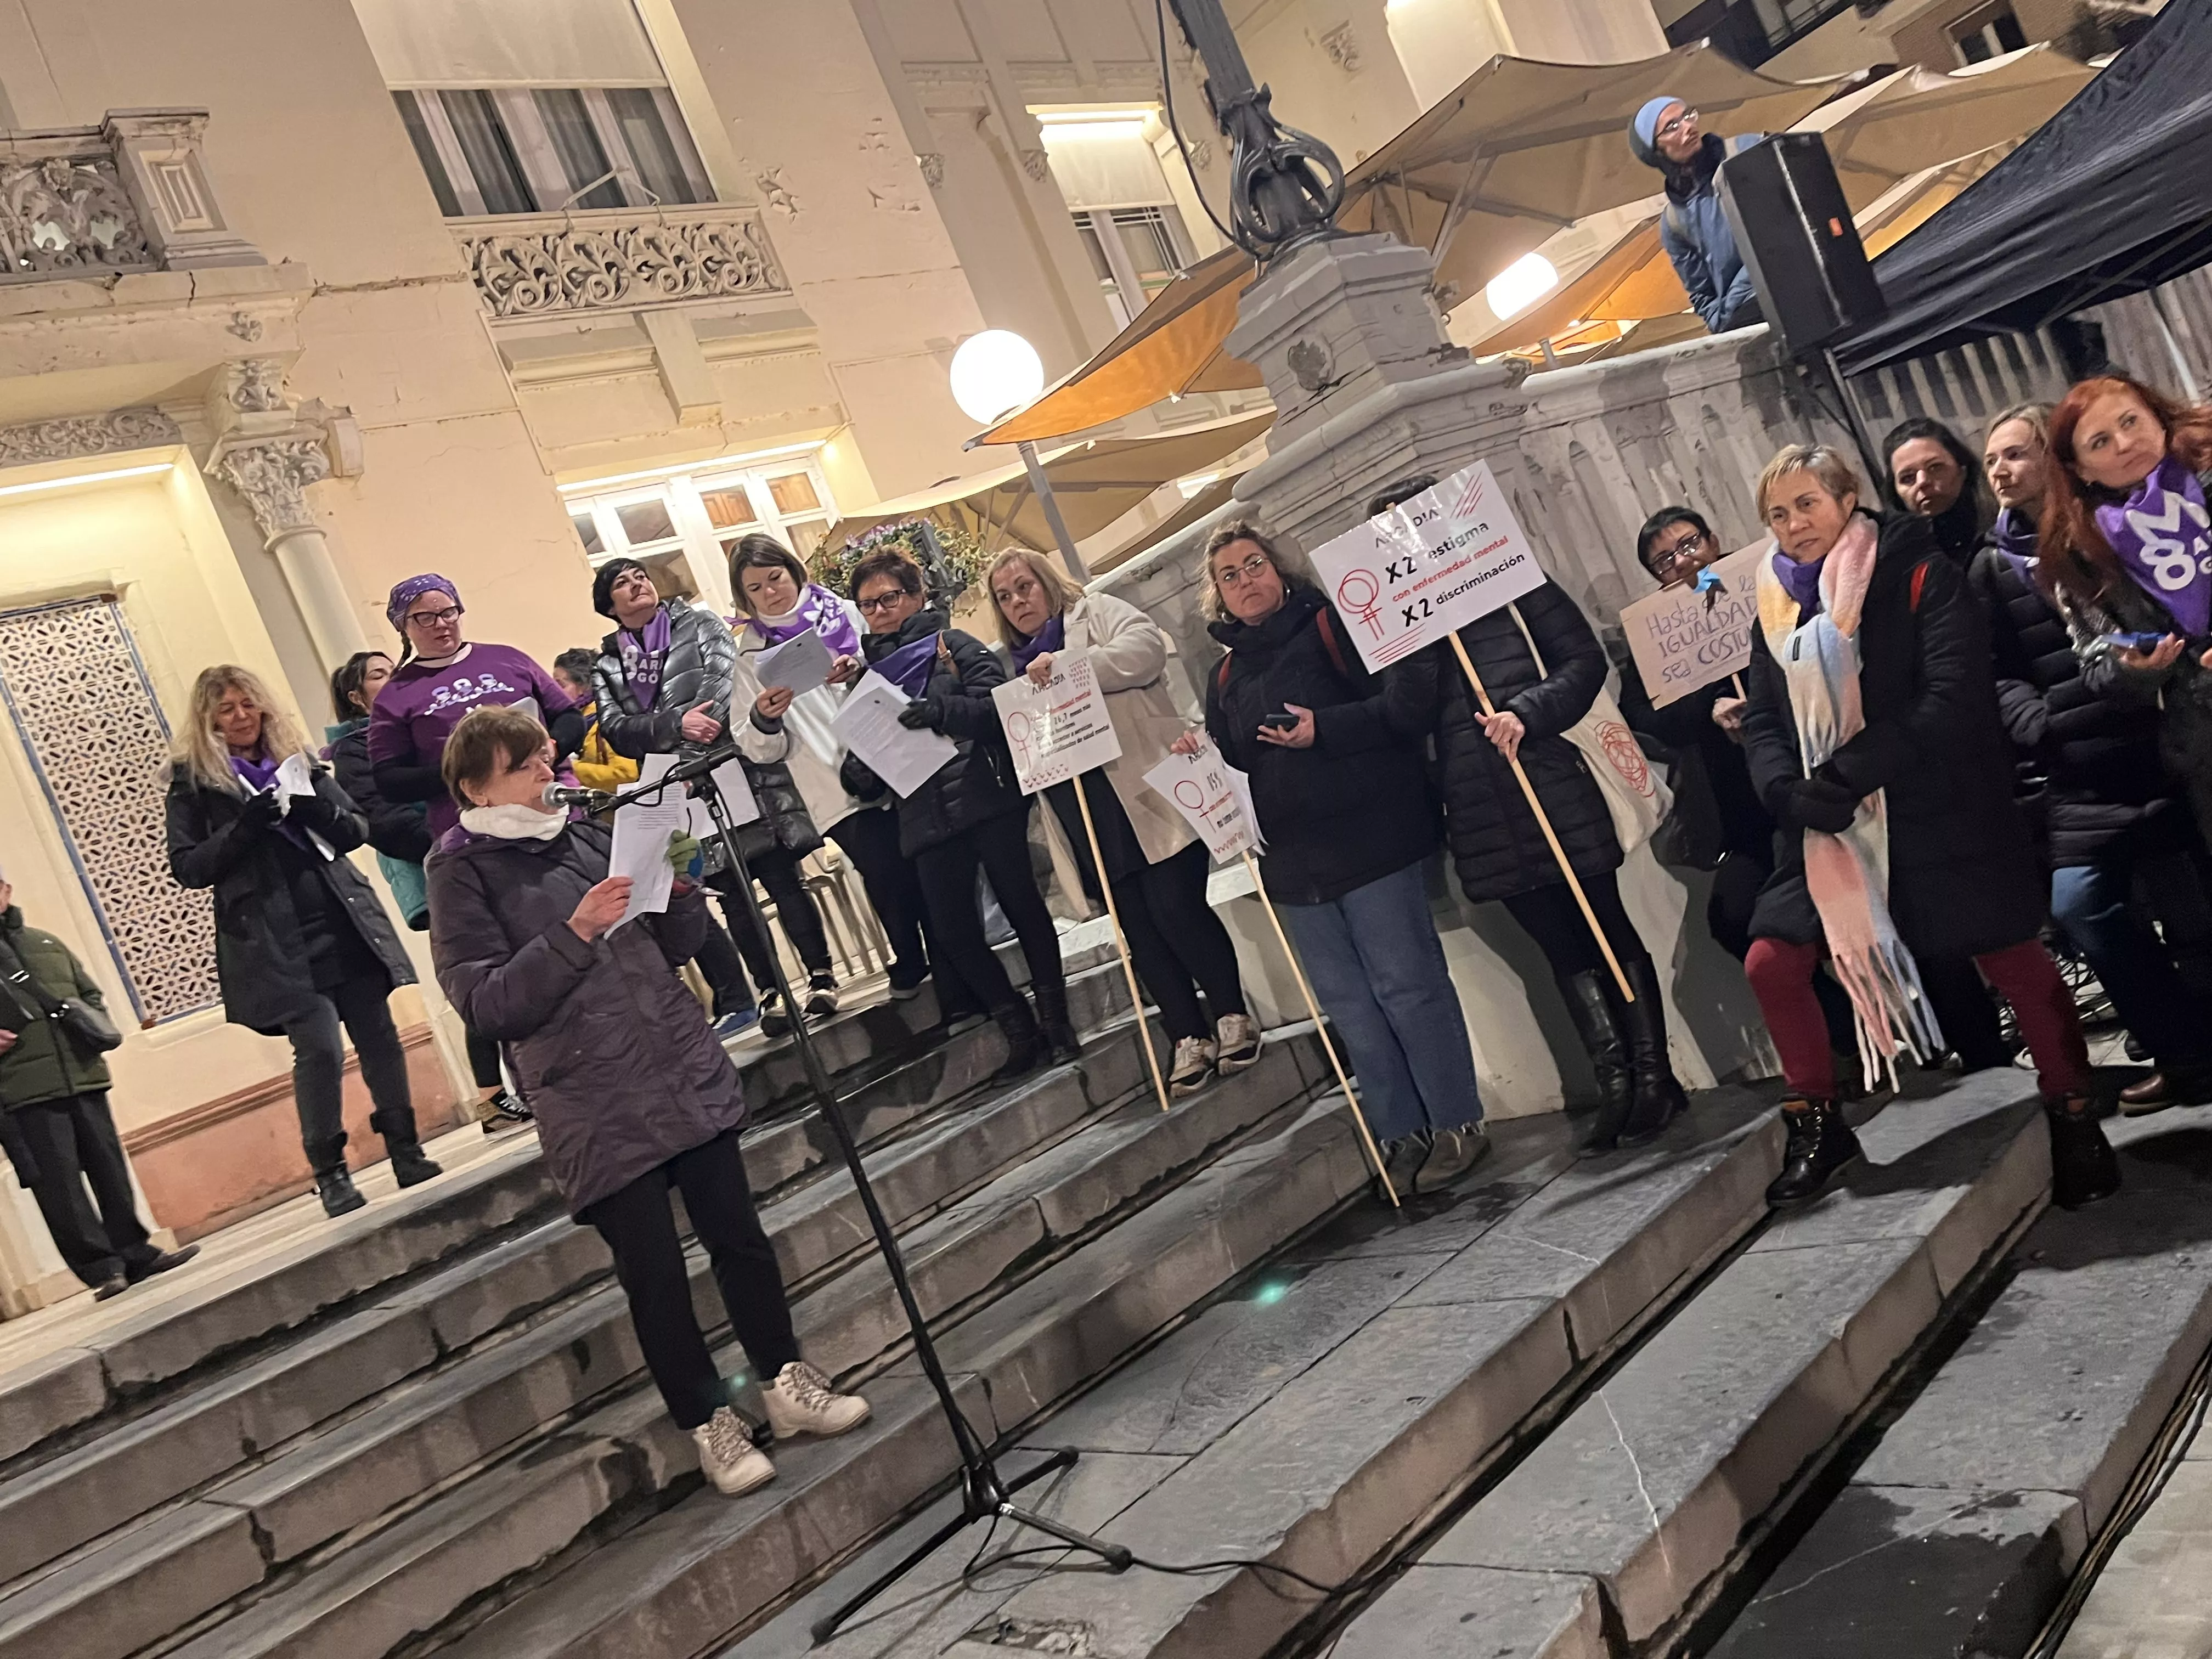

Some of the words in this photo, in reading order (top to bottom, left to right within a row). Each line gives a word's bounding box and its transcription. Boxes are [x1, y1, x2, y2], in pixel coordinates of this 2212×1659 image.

[1428, 522, 1489, 559] estigma
[1392, 589, 1410, 602] con
[1413, 555, 1471, 592] enfermedad
[1473, 535, 1509, 560] mental
[1436, 554, 1525, 605] discriminación
[1645, 599, 1699, 640] Hasta
[1658, 595, 1758, 658] IGUALDAD
